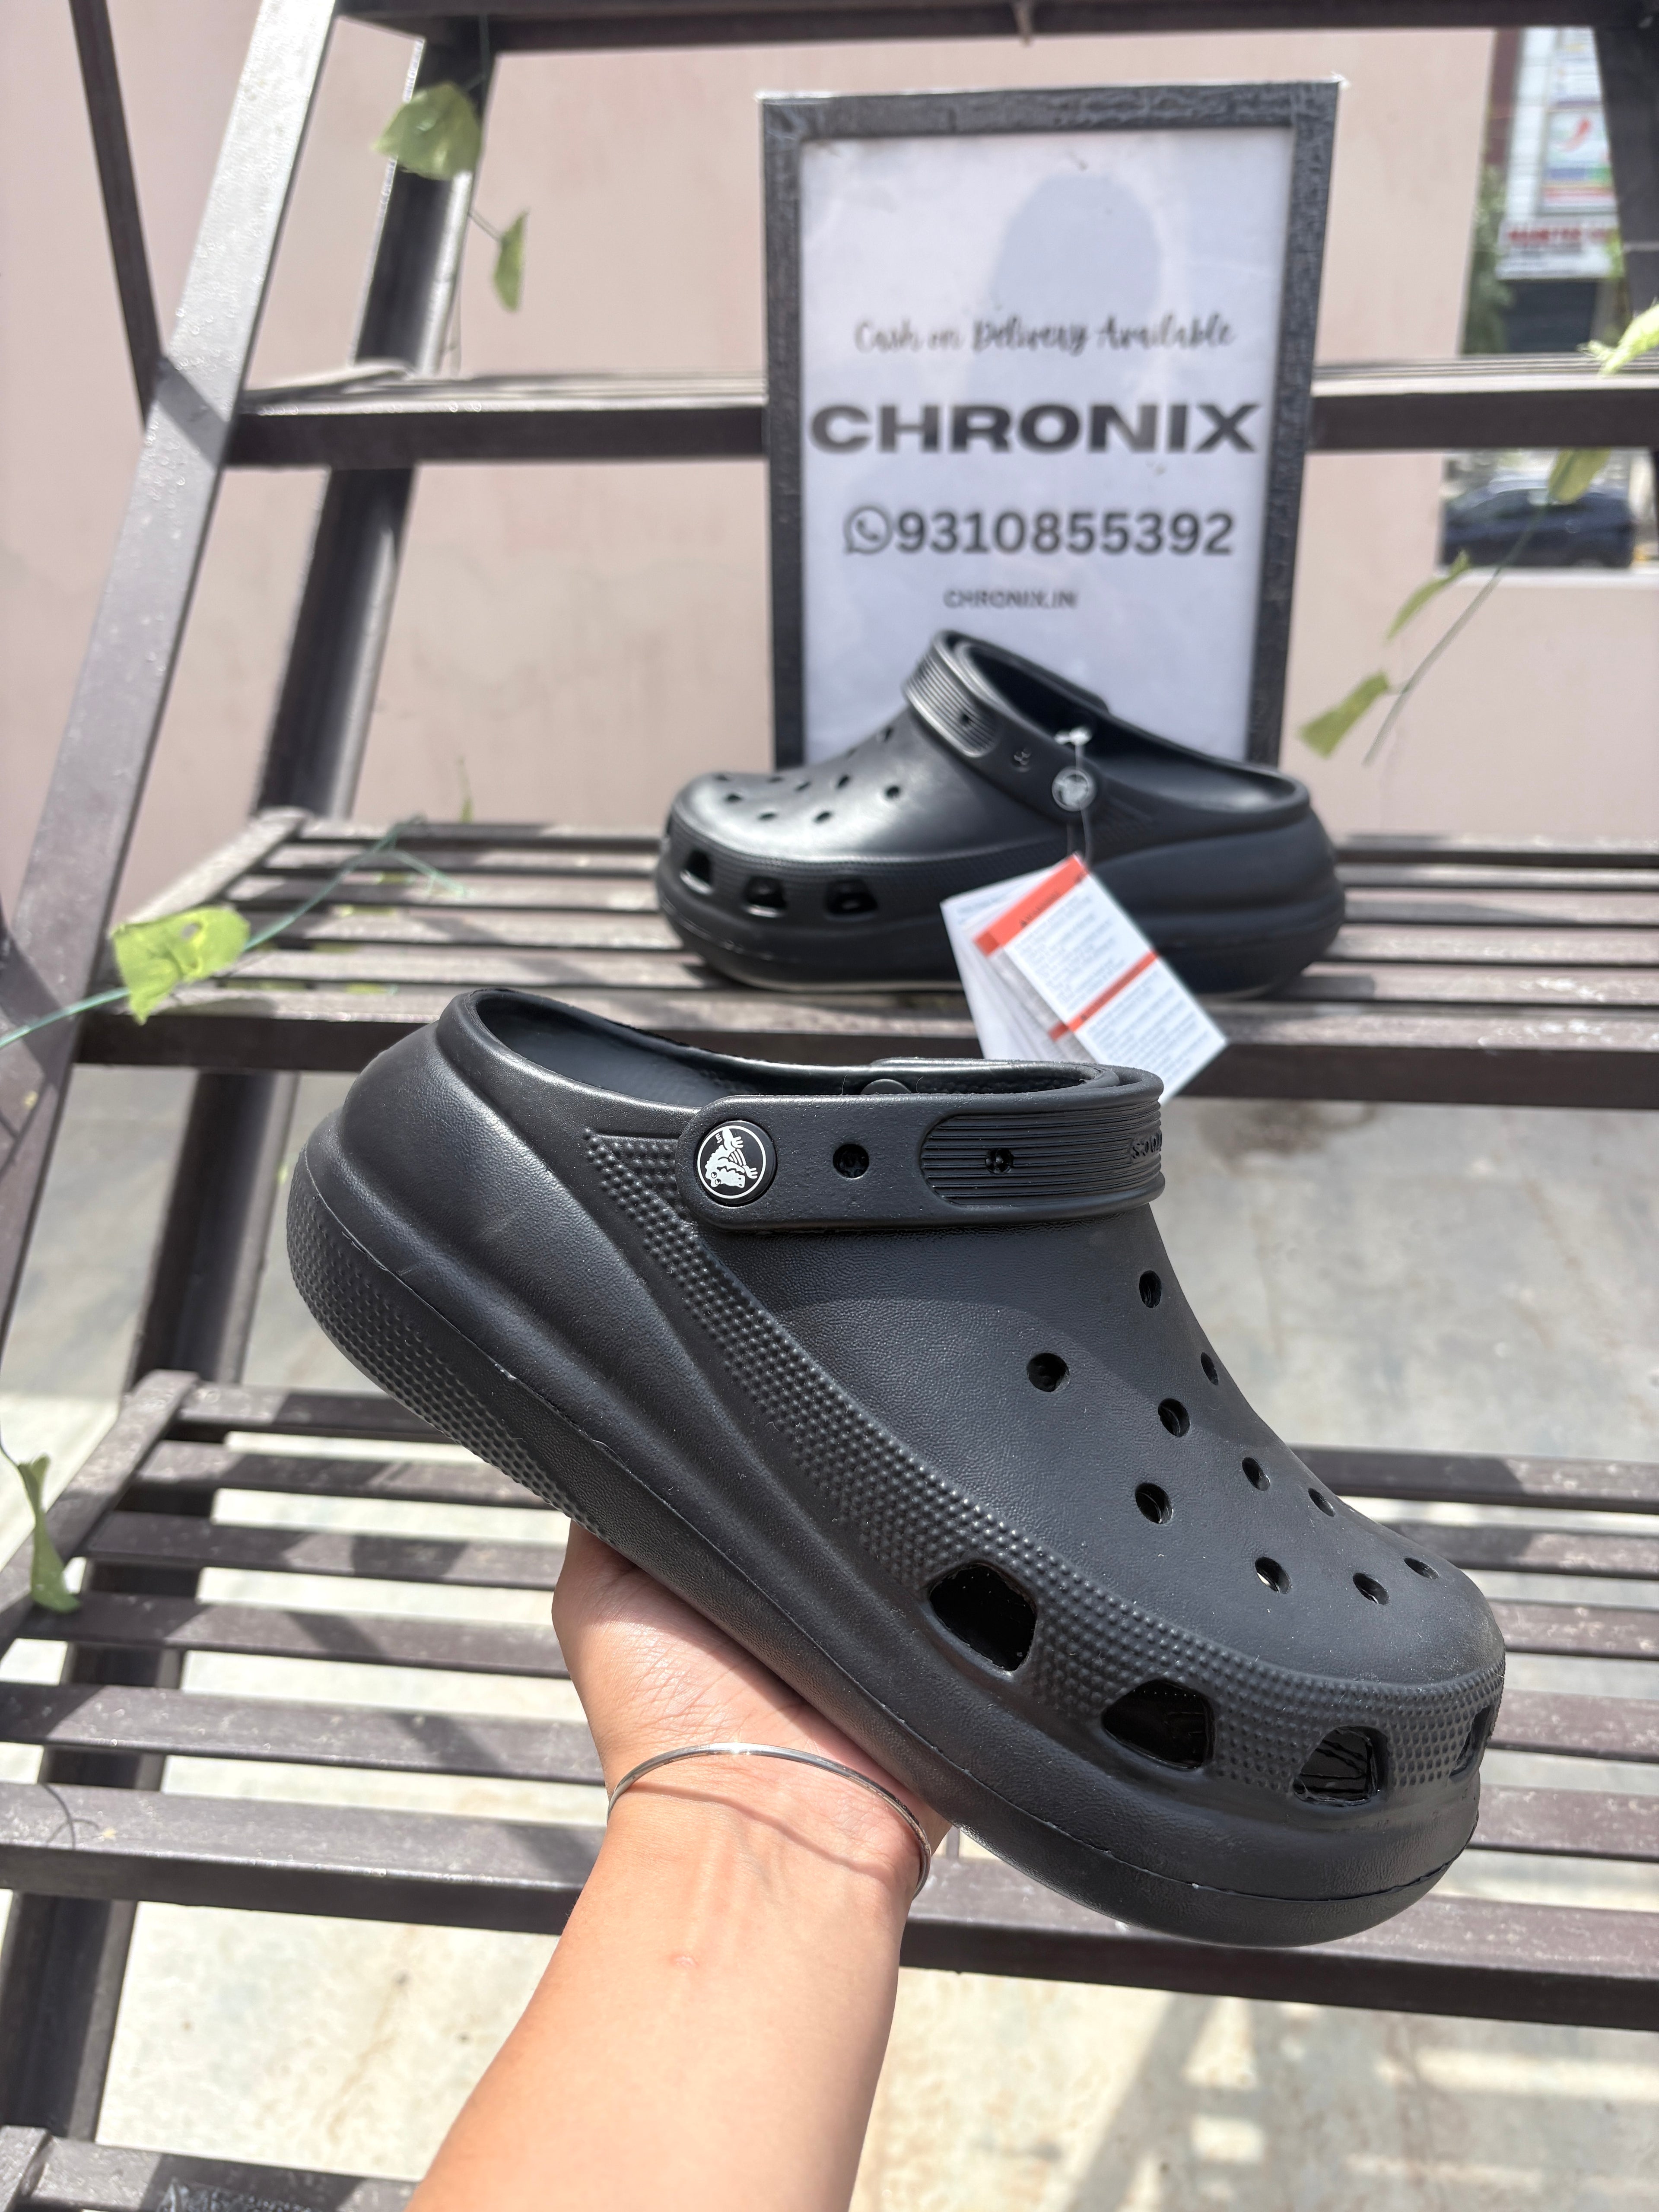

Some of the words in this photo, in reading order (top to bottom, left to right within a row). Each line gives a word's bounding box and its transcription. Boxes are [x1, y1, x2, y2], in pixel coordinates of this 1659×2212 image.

[854, 318, 922, 353] Cash
[972, 314, 1087, 357] Delivery
[1095, 312, 1236, 350] Available
[810, 403, 1259, 454] CHRONIX
[896, 510, 1233, 556] 9310855392
[942, 588, 1078, 608] CHRONIX.IN
